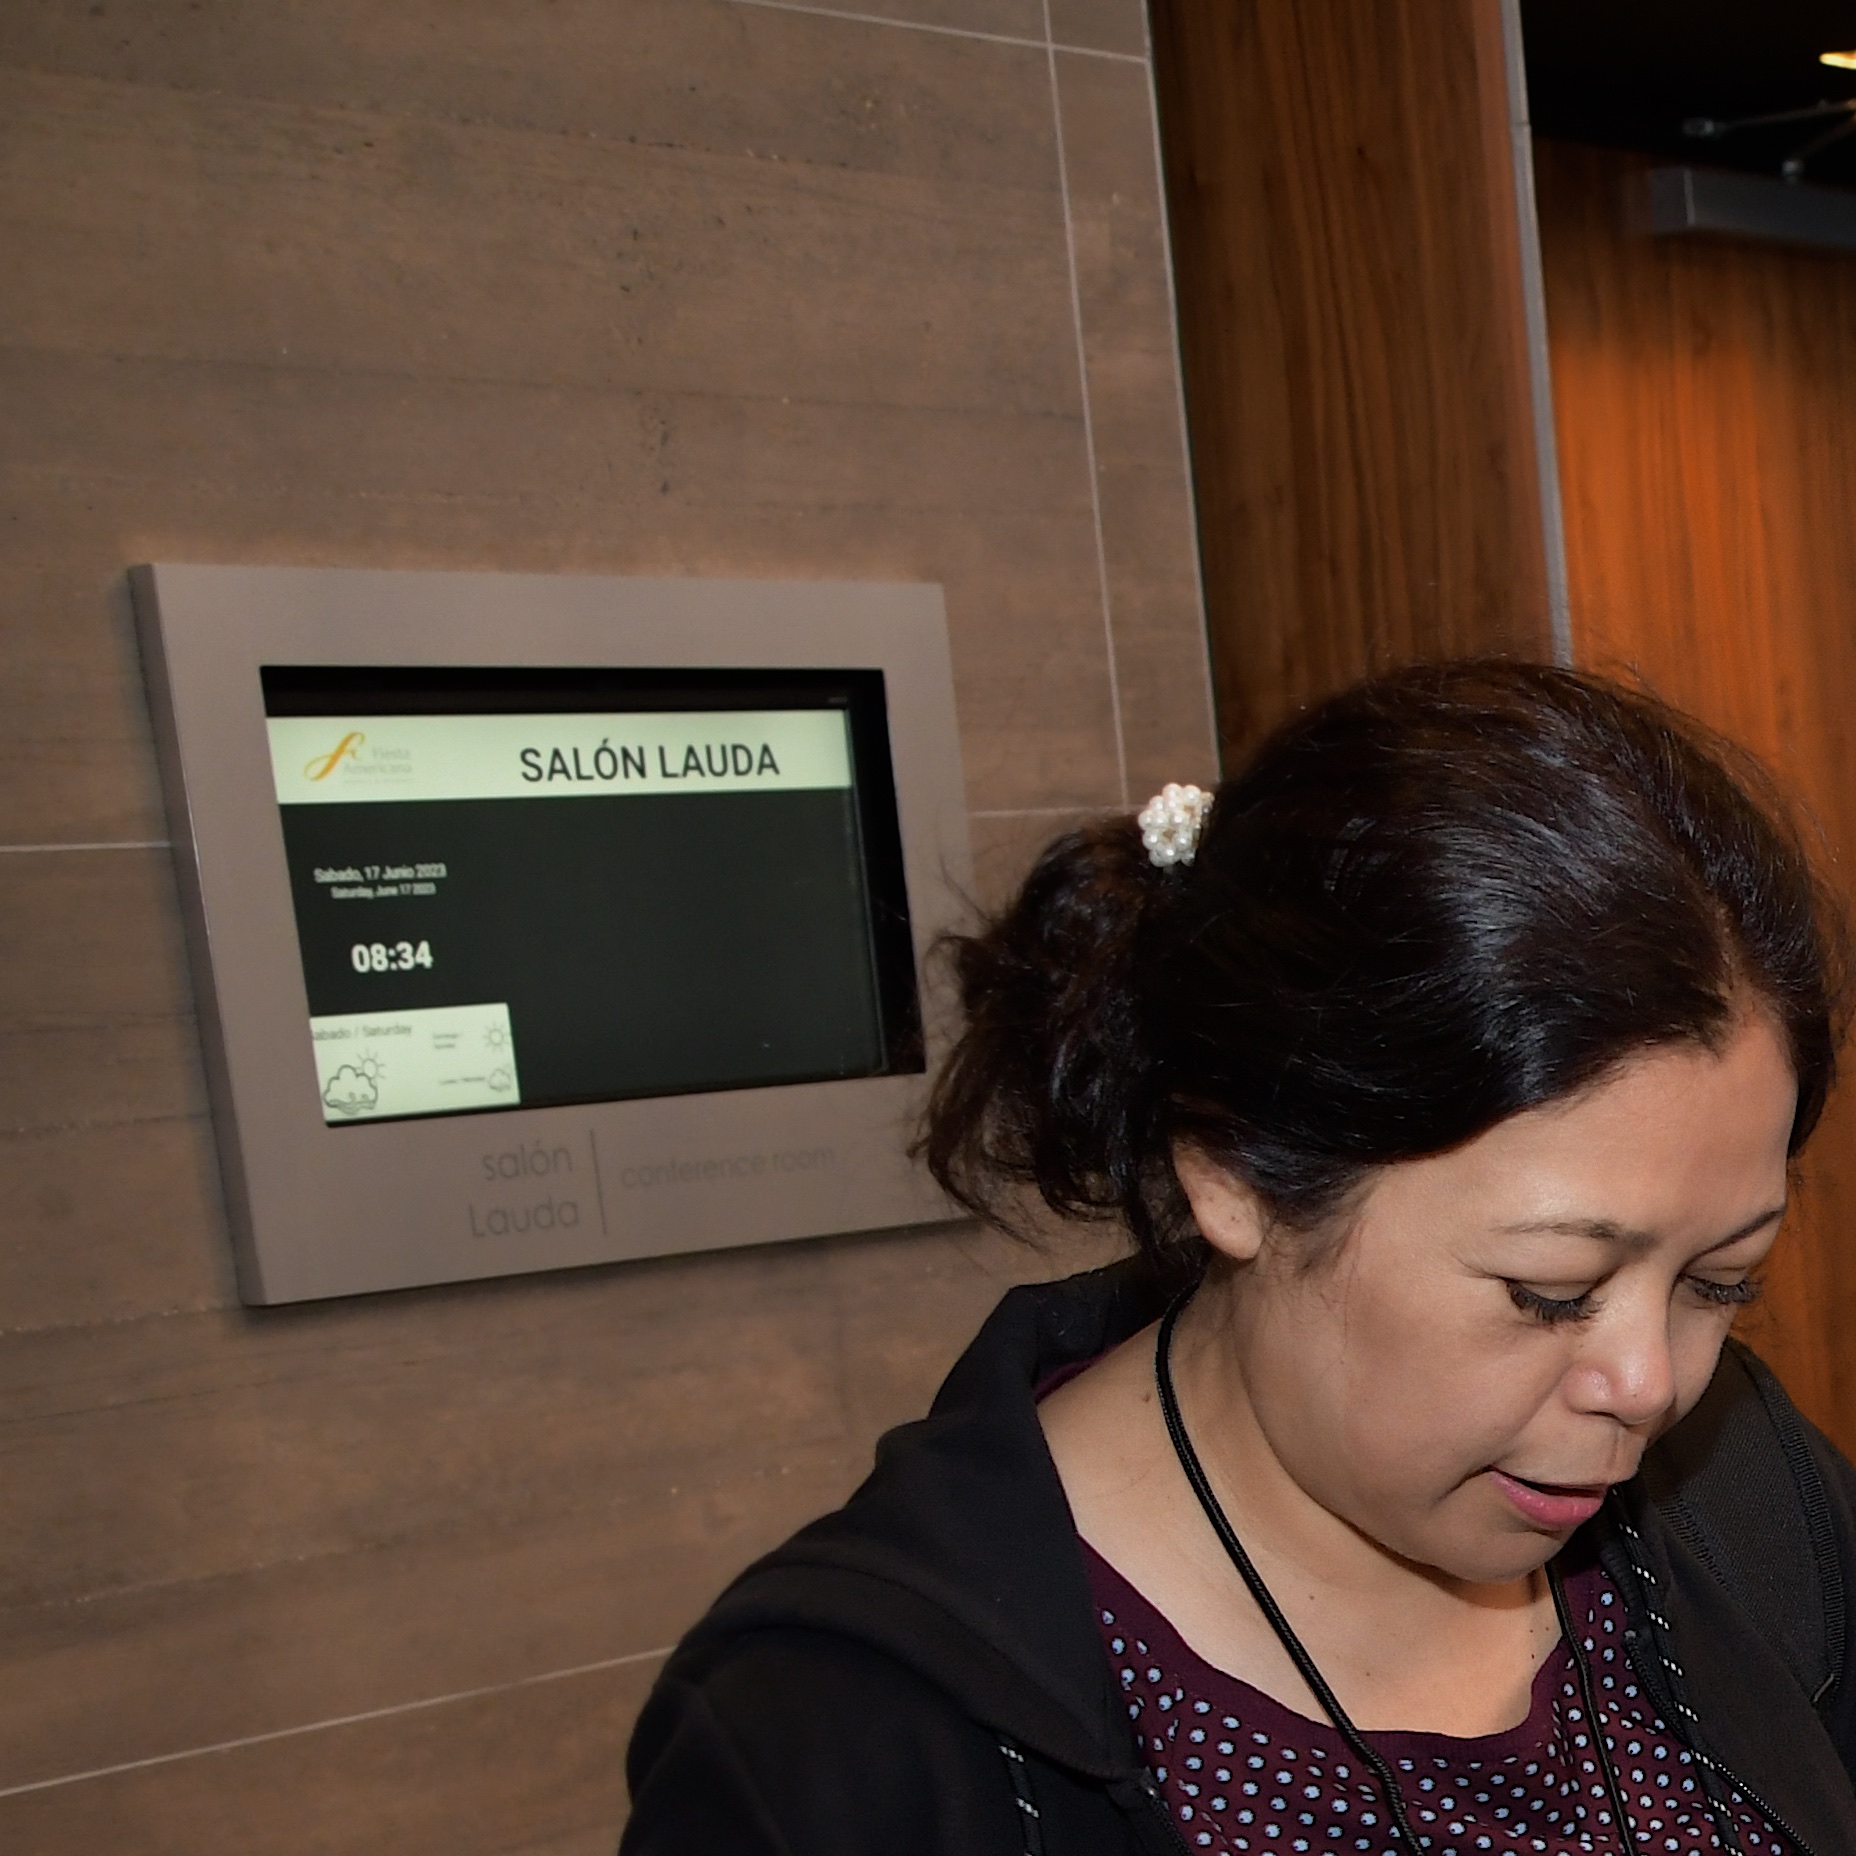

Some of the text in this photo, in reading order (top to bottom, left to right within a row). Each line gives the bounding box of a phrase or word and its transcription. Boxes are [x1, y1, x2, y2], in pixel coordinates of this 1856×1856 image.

[519, 738, 780, 782] SALÓN LAUDA
[364, 865, 380, 880] 17
[351, 940, 433, 973] 08:34
[312, 1027, 350, 1041] abado
[482, 1139, 574, 1181] salón
[468, 1196, 580, 1238] Lauda
